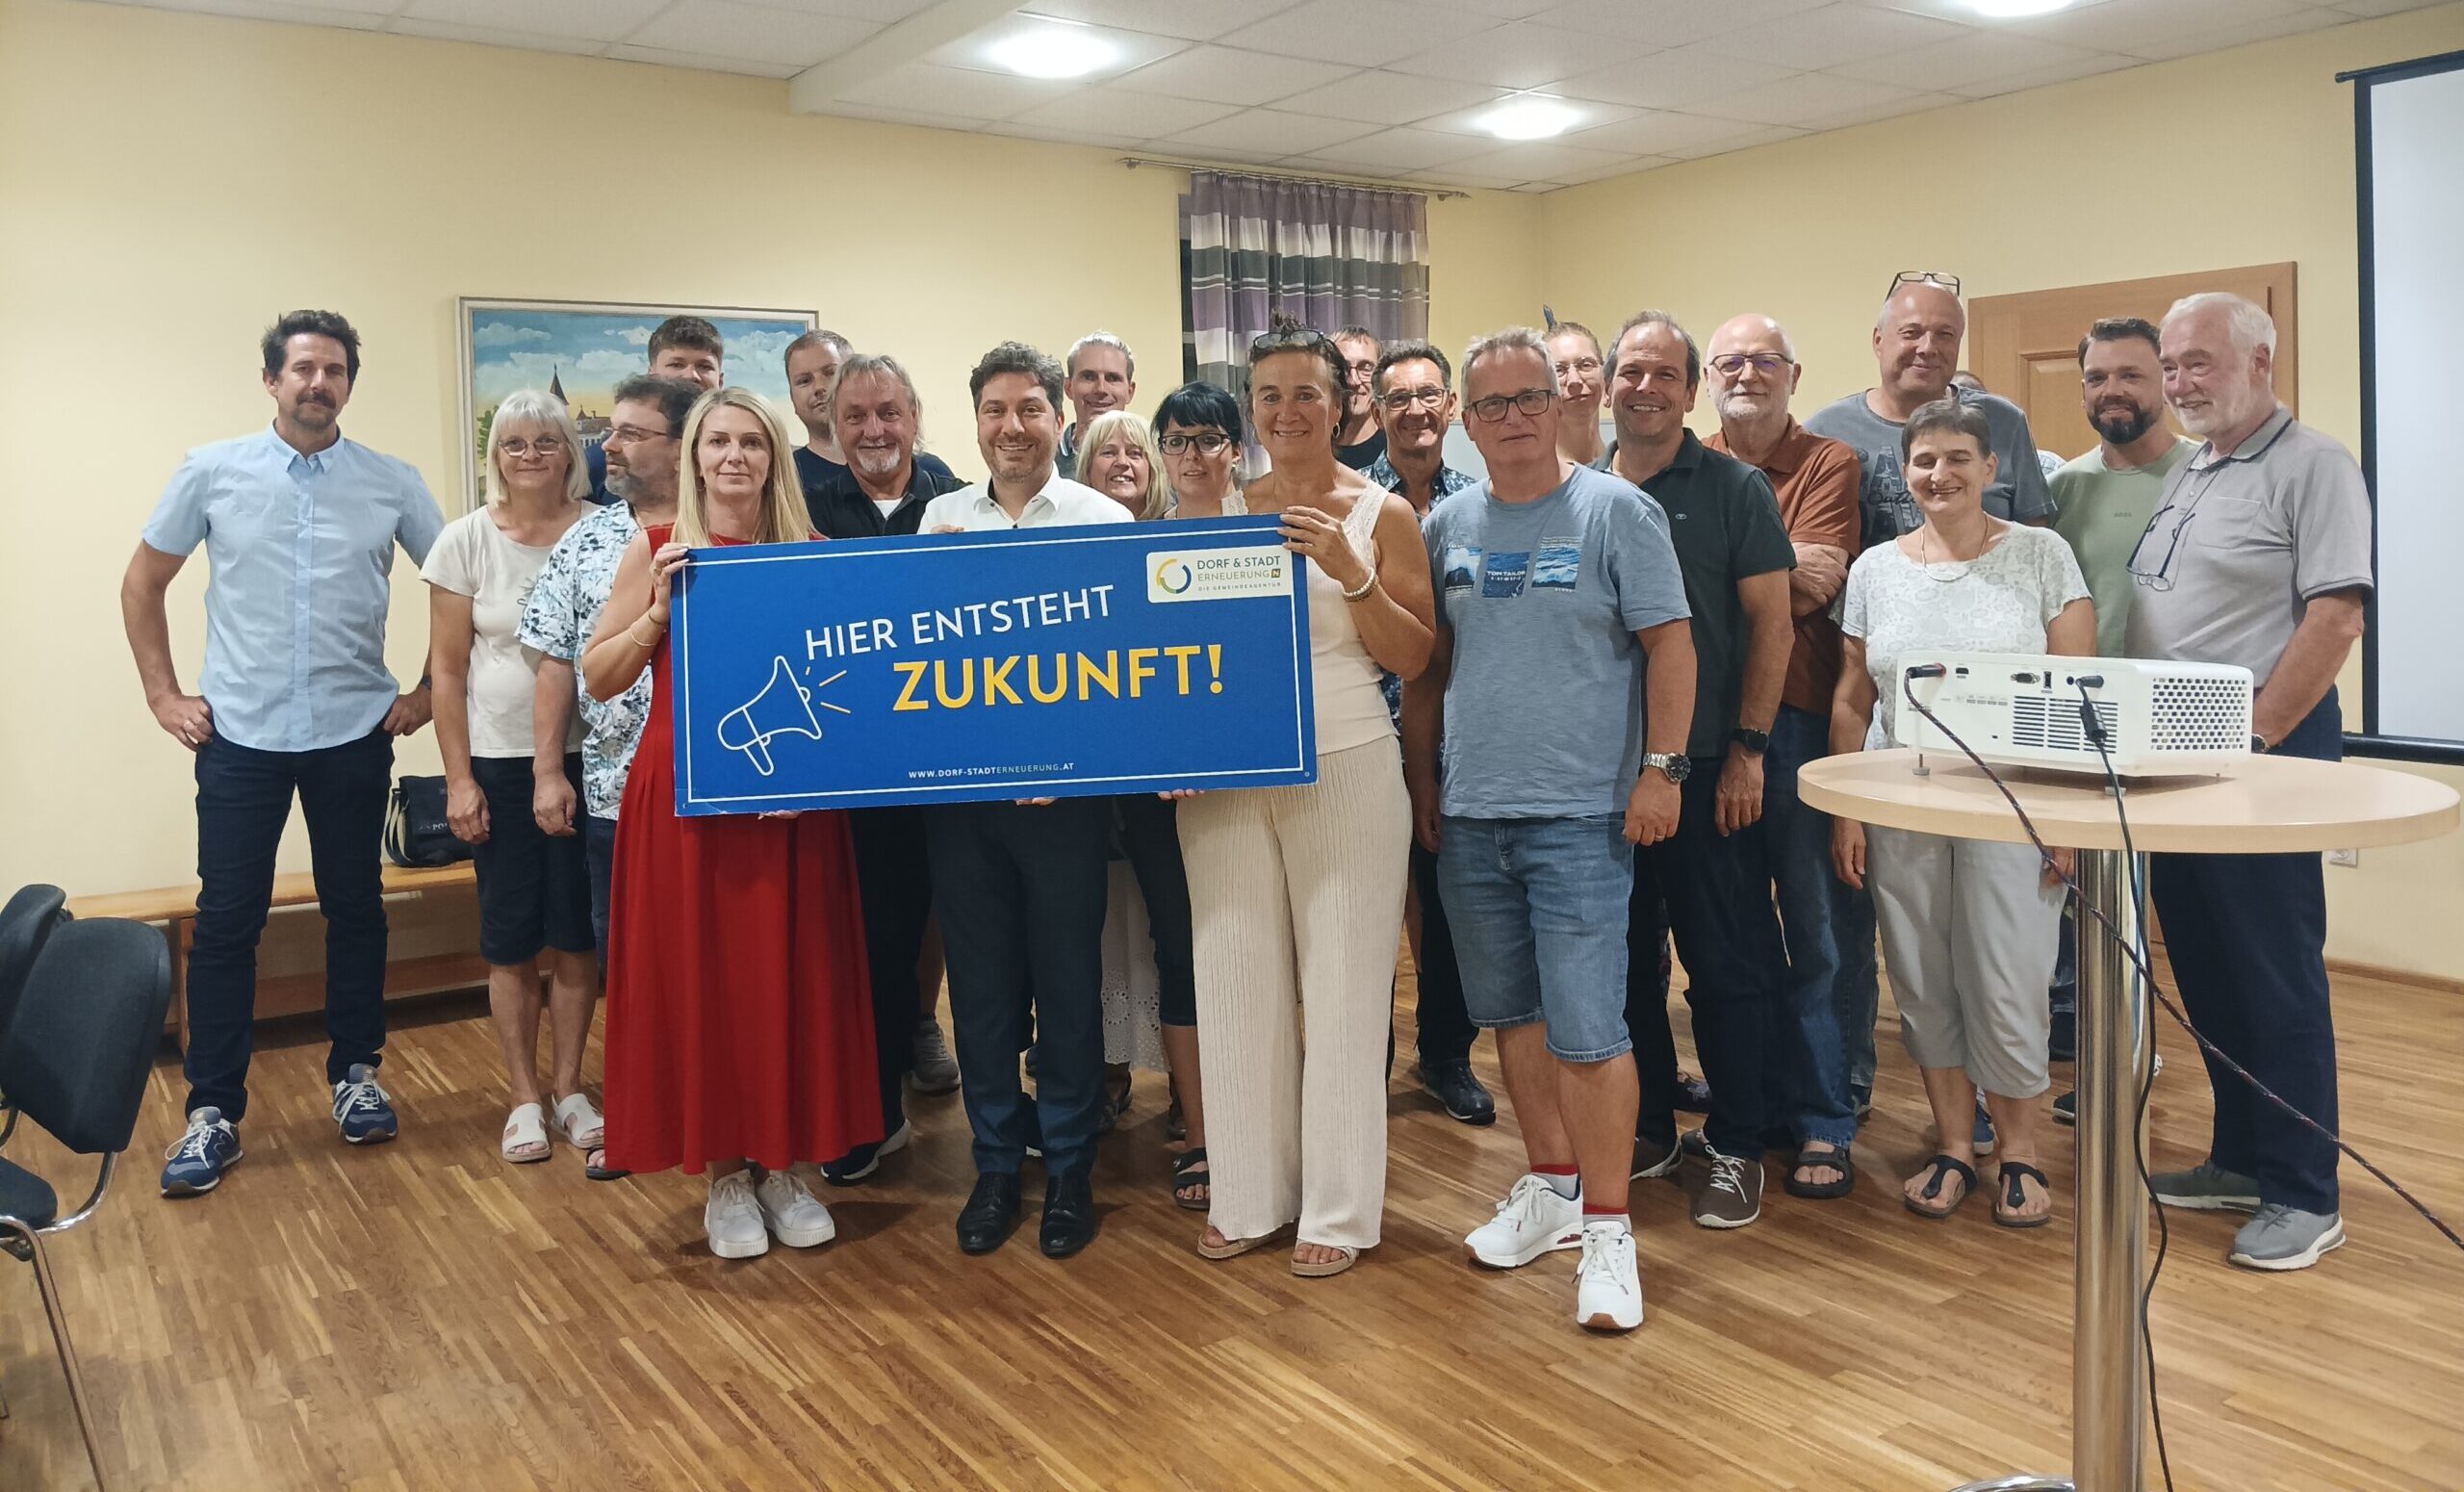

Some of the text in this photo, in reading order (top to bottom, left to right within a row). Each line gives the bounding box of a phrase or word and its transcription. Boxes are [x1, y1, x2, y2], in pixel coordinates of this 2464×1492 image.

[1196, 555, 1281, 570] DORF & STADT
[1197, 569, 1270, 581] ERNEUERUNG
[806, 584, 1114, 660] HIER ENTSTEHT
[892, 644, 1223, 711] ZUKUNFT!
[908, 762, 1074, 779] WWW.DORF-STADTERNEUERUNG.AT
